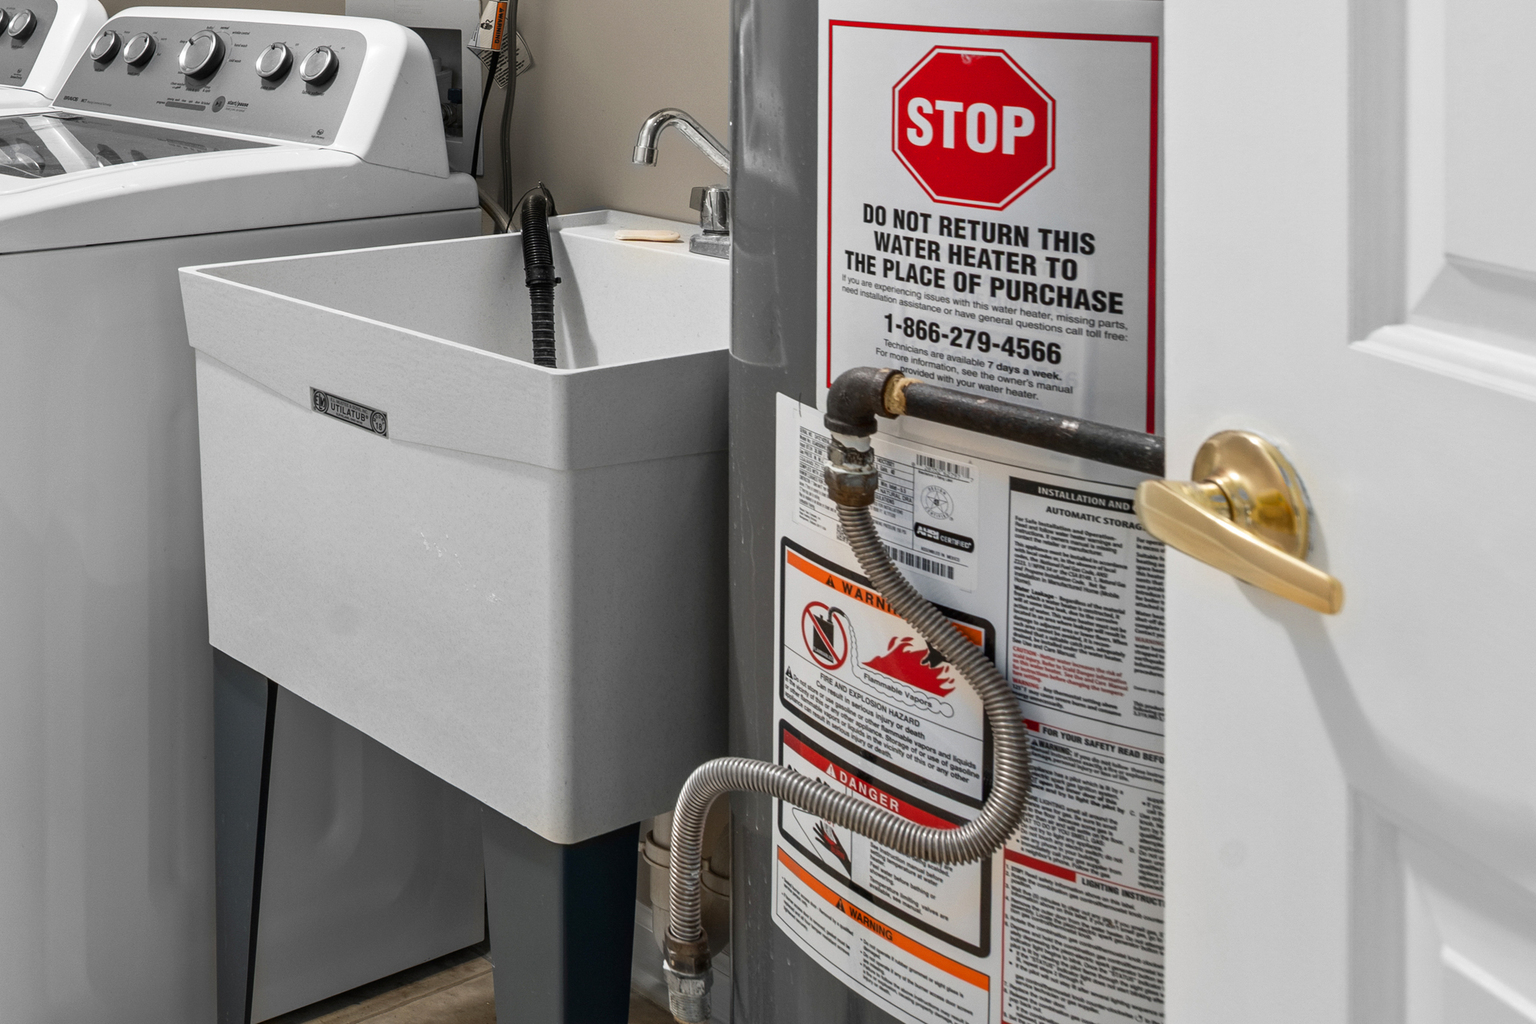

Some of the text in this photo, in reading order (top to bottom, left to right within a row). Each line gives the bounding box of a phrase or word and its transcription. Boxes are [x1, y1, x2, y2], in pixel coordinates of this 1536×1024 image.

[494, 13, 504, 44] WARNING
[906, 96, 1035, 155] STOP
[863, 203, 1095, 256] DO NOT RETURN THIS
[874, 230, 1077, 281] WATER HEATER TO
[845, 250, 1124, 315] THE PLACE OF PURCHASE
[848, 276, 860, 285] you
[861, 280, 873, 288] are
[874, 283, 922, 300] experiencing
[924, 292, 951, 304] issues
[952, 297, 971, 307] with
[972, 300, 989, 311] this
[991, 304, 1018, 315] water
[1019, 307, 1054, 321] heater,
[1056, 313, 1096, 328] missing
[1098, 319, 1128, 330] parts,
[842, 285, 1128, 342] need installation assistance or have general questions call toll free:
[883, 313, 1062, 365] 1-866-279-4566
[883, 338, 1063, 381] Technicians are available 7 days a week.
[876, 347, 1074, 395] For more information, see the owner's manual
[900, 366, 1039, 401] provided with your water heater.
[376, 422, 383, 431] 18
[1037, 486, 1130, 511] INSTALLATION AND
[1046, 506, 1146, 531] AUTOMATIC STORAG
[940, 535, 970, 549] CERTIFIED
[842, 581, 897, 615] WARNI
[816, 680, 827, 691] Can
[827, 688, 843, 701] result
[844, 696, 850, 705] in
[852, 701, 874, 717] serious
[875, 712, 894, 728] injury
[905, 726, 925, 740] death
[820, 672, 920, 727] FIRE AND EXPLOSION HAZARD
[864, 673, 932, 708] Flammable Vapors
[1042, 726, 1059, 738] FOR
[1060, 731, 1083, 745] YOUR
[1084, 736, 1116, 753] SAFETY
[1117, 747, 1141, 759] READ
[840, 771, 900, 813] DANGER
[869, 875, 949, 921] Temperature limiting valves are
[869, 883, 924, 915] available, see manual.
[1081, 878, 1165, 908] LIGHTING INSTRUCT
[849, 906, 894, 942] WARNING
